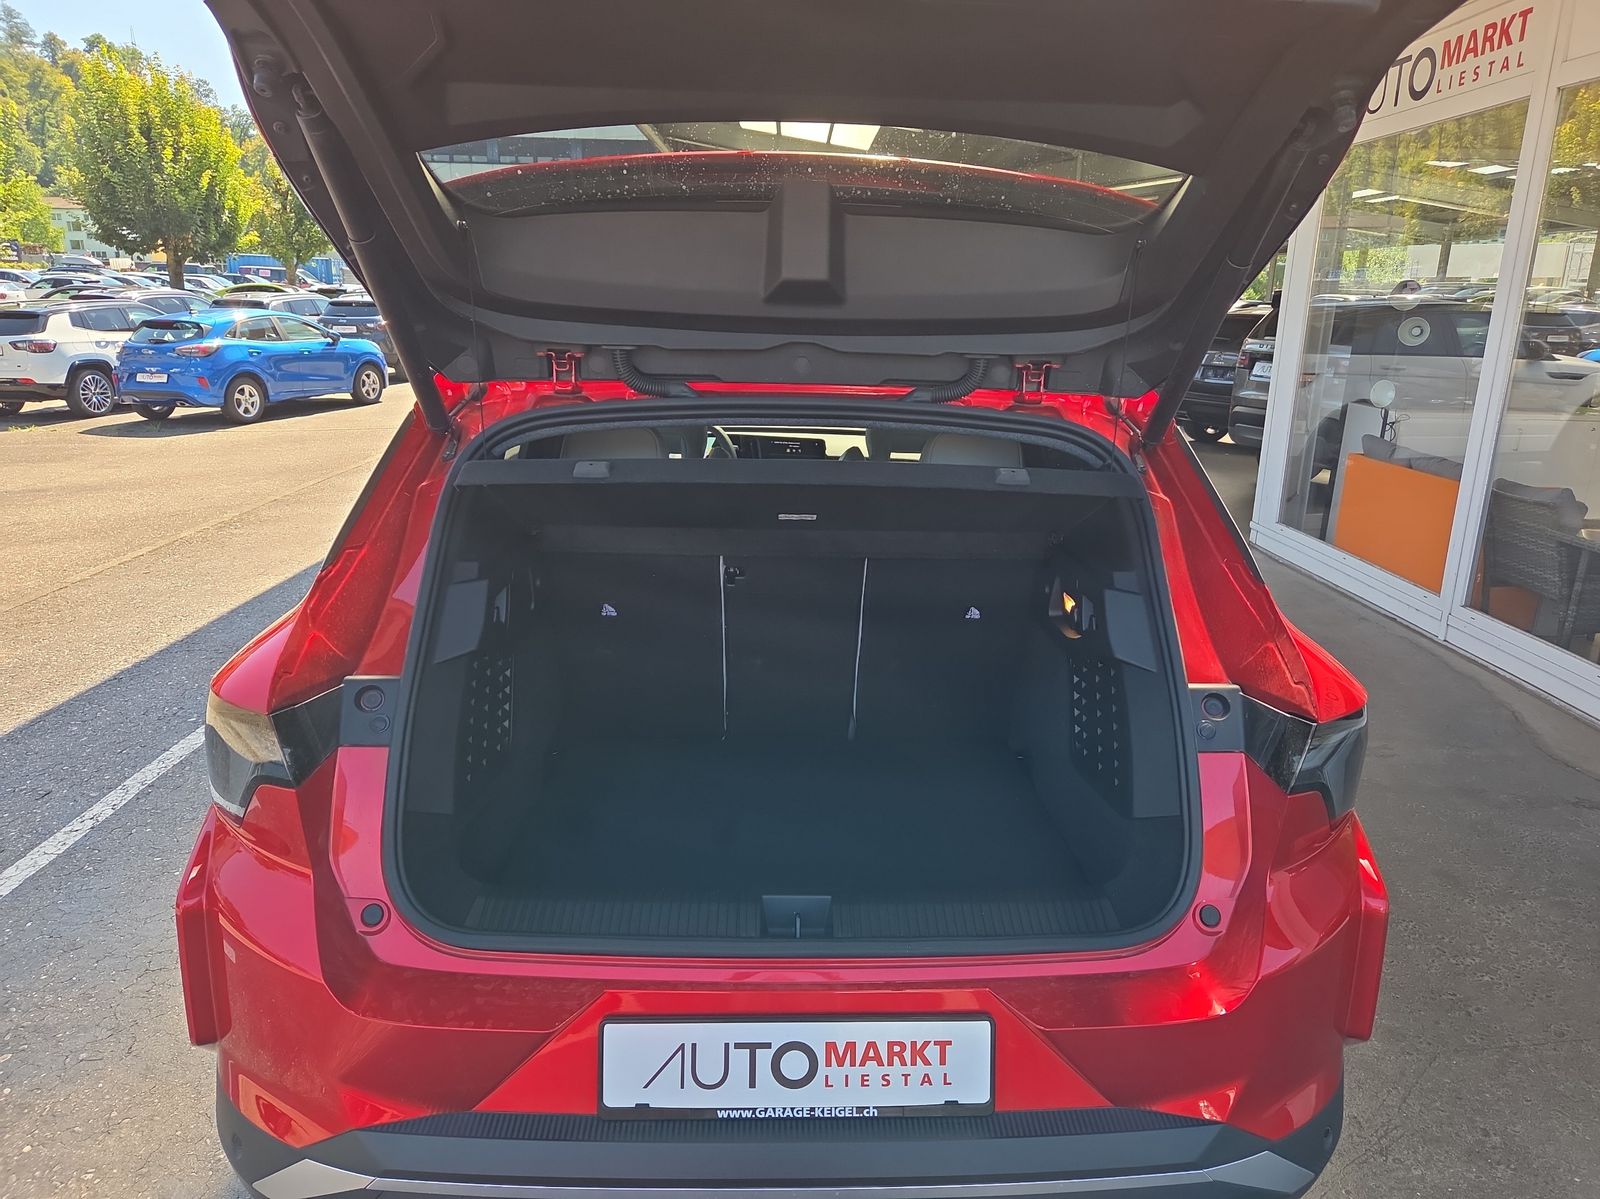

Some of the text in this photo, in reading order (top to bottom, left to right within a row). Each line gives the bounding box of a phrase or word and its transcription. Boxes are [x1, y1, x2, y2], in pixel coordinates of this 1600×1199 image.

[1366, 6, 1534, 115] UTO MARKT
[1436, 51, 1524, 94] LIESTAL
[642, 1040, 953, 1089] AUTO MARKT
[824, 1073, 952, 1088] LIESTAL
[717, 1105, 878, 1119] www.GARAGE-KEIGEL.ch
